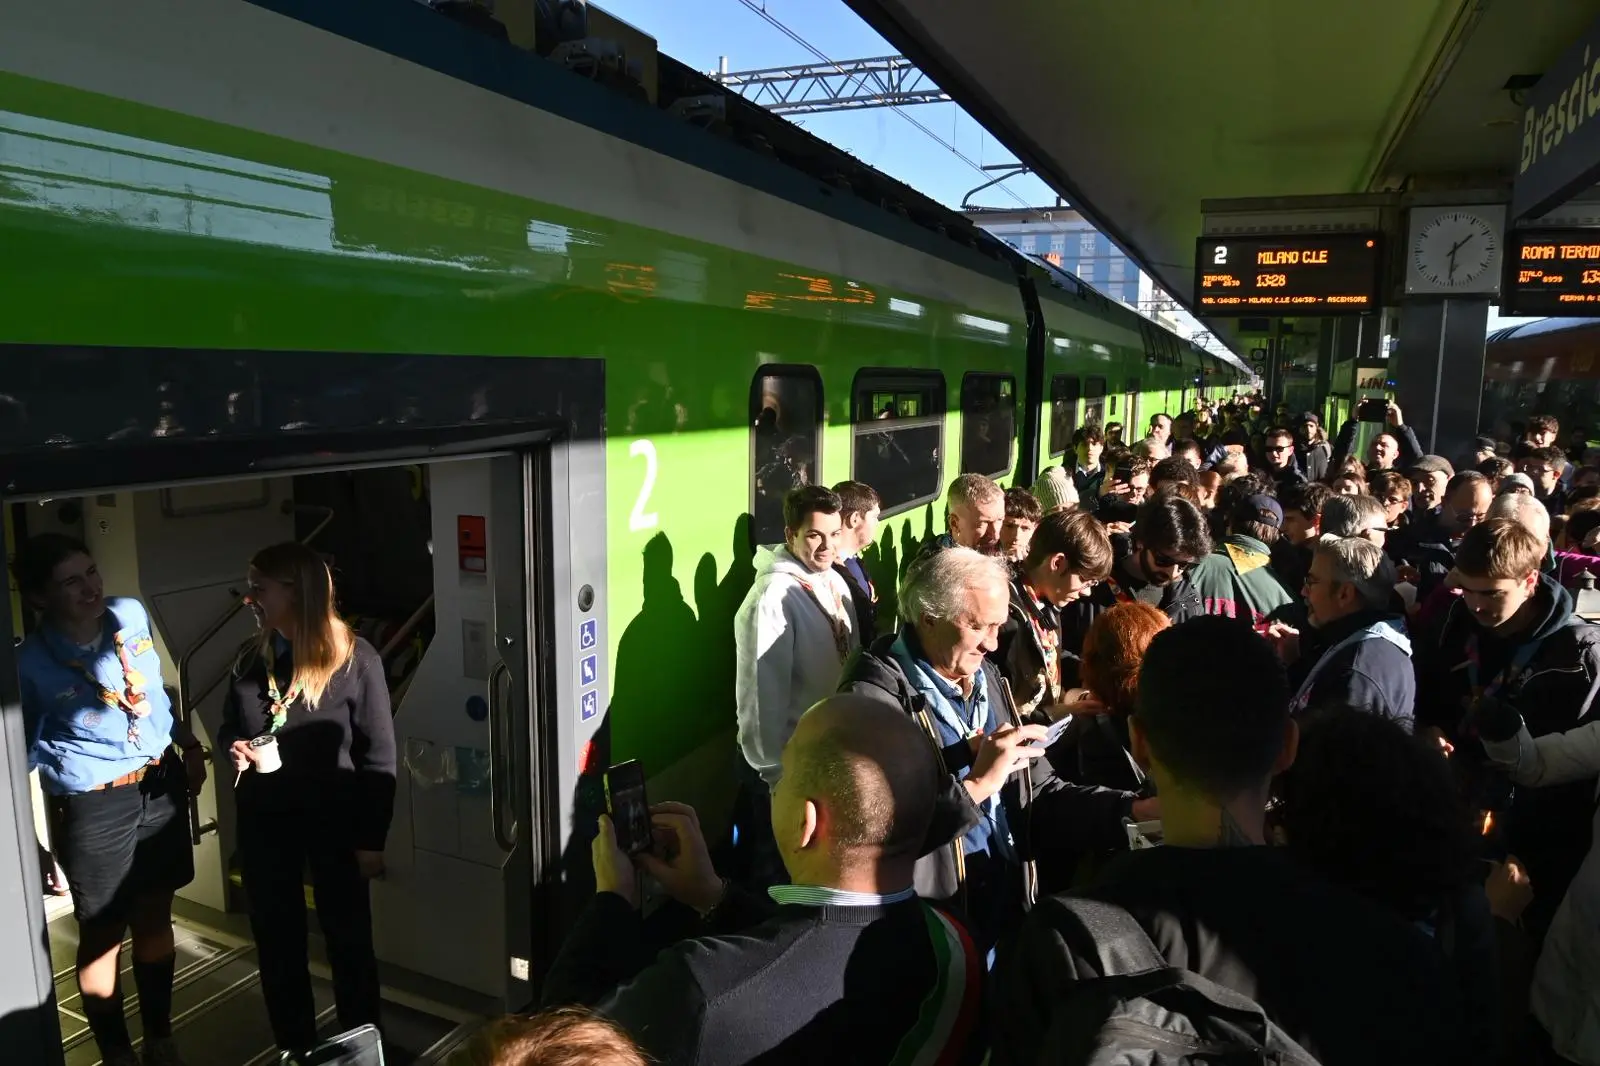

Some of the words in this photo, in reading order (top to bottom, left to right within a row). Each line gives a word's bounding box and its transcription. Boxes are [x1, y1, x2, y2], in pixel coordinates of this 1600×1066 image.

[1519, 43, 1600, 176] Brescia
[1214, 246, 1228, 265] 2
[1257, 251, 1300, 265] MILANO
[1521, 246, 1556, 260] ROMA
[1255, 274, 1286, 287] 13:28
[1519, 270, 1544, 278] ITALO
[1559, 294, 1585, 302] FERMA
[629, 438, 659, 533] 2
